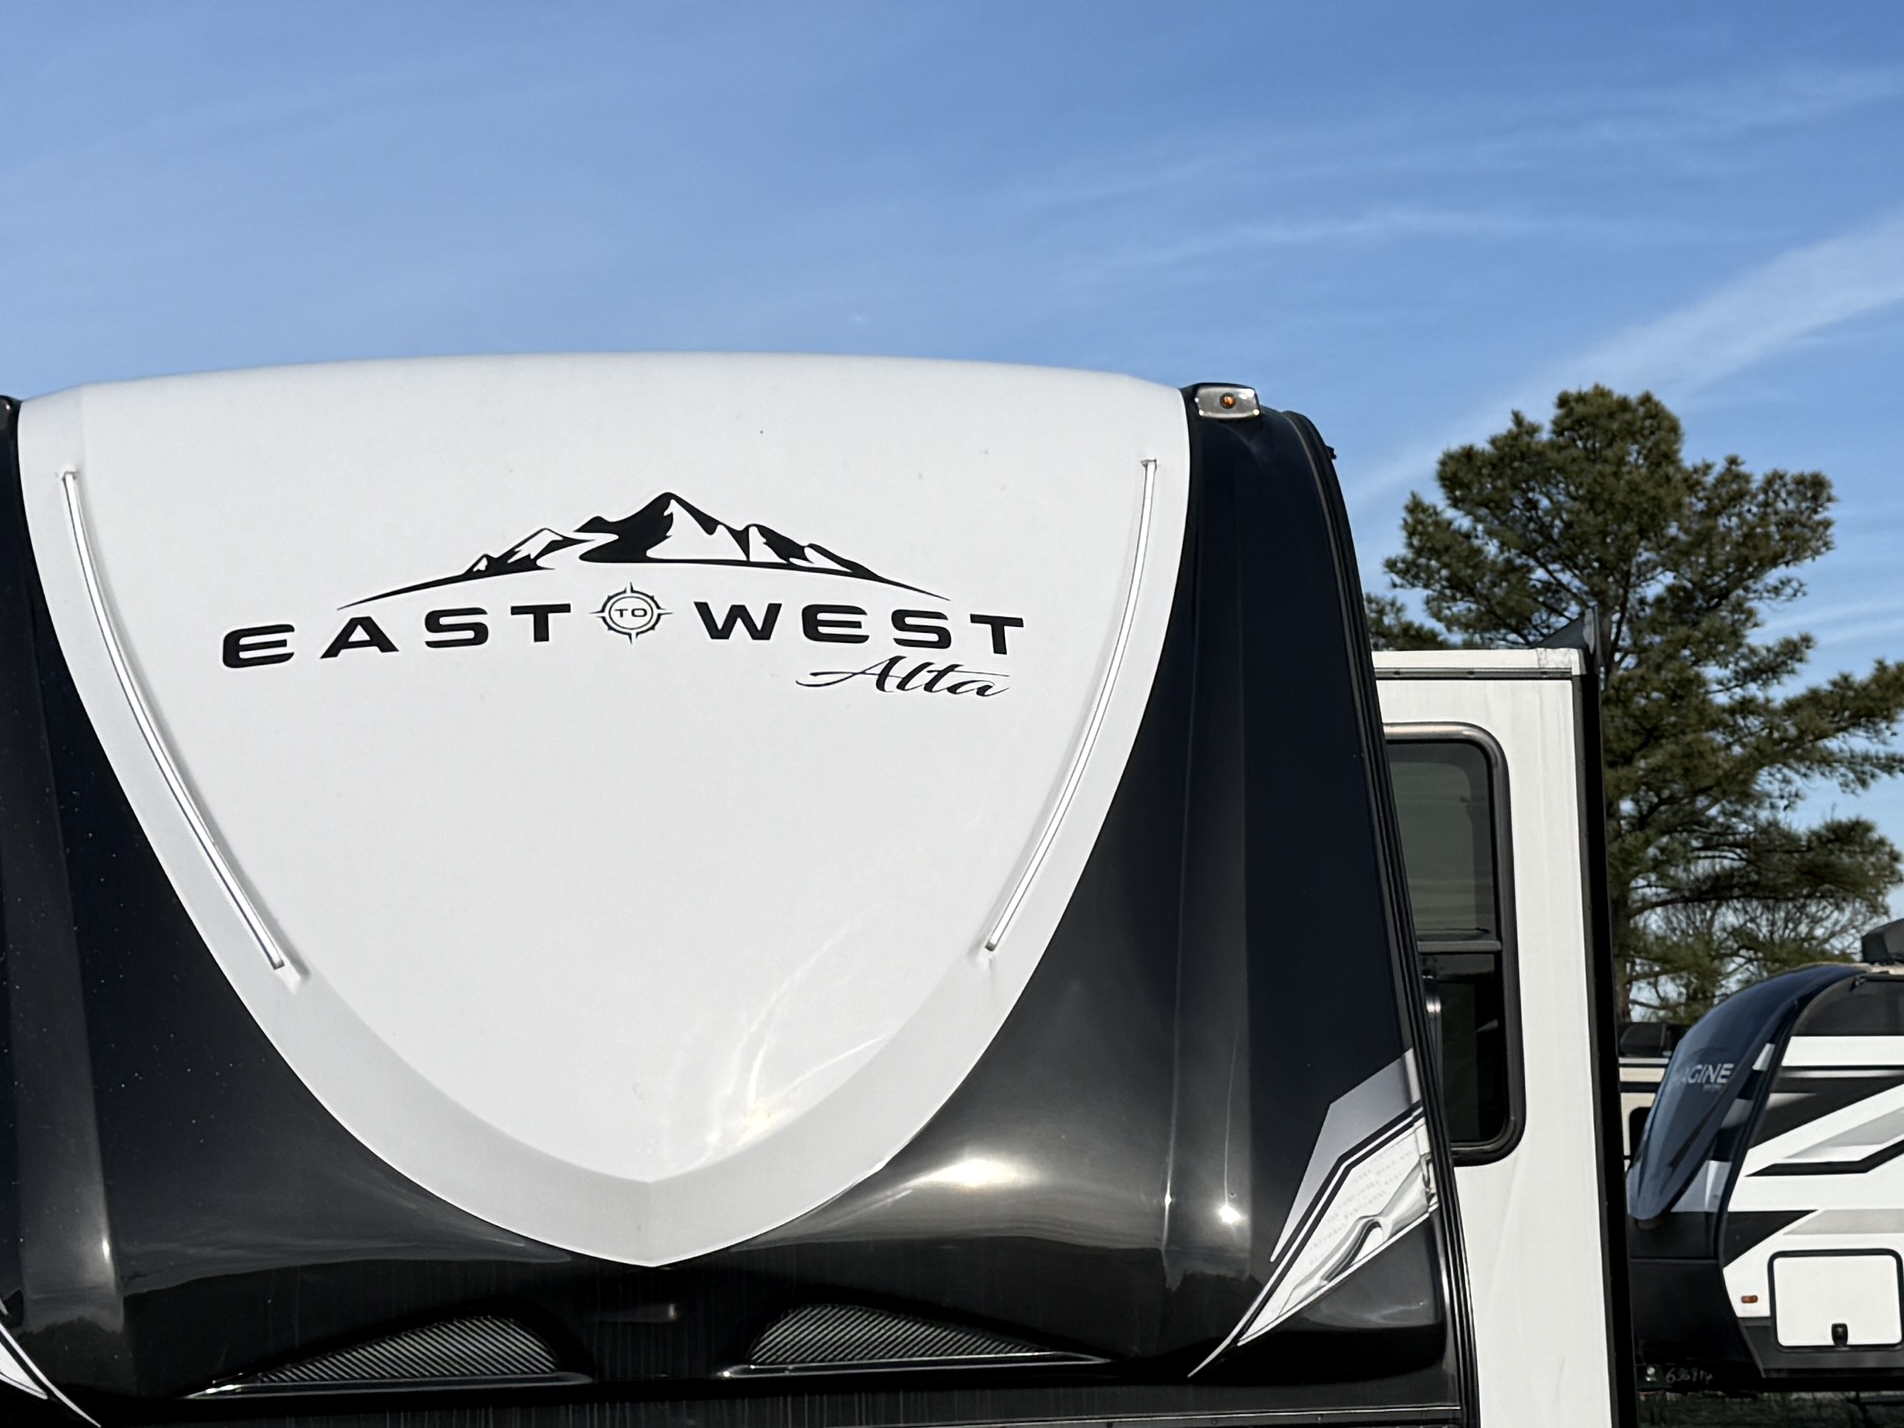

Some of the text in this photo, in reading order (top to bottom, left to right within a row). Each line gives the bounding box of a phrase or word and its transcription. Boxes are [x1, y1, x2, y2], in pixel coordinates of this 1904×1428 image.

[222, 601, 1026, 670] EAST TO WEST
[796, 655, 1010, 698] Alta
